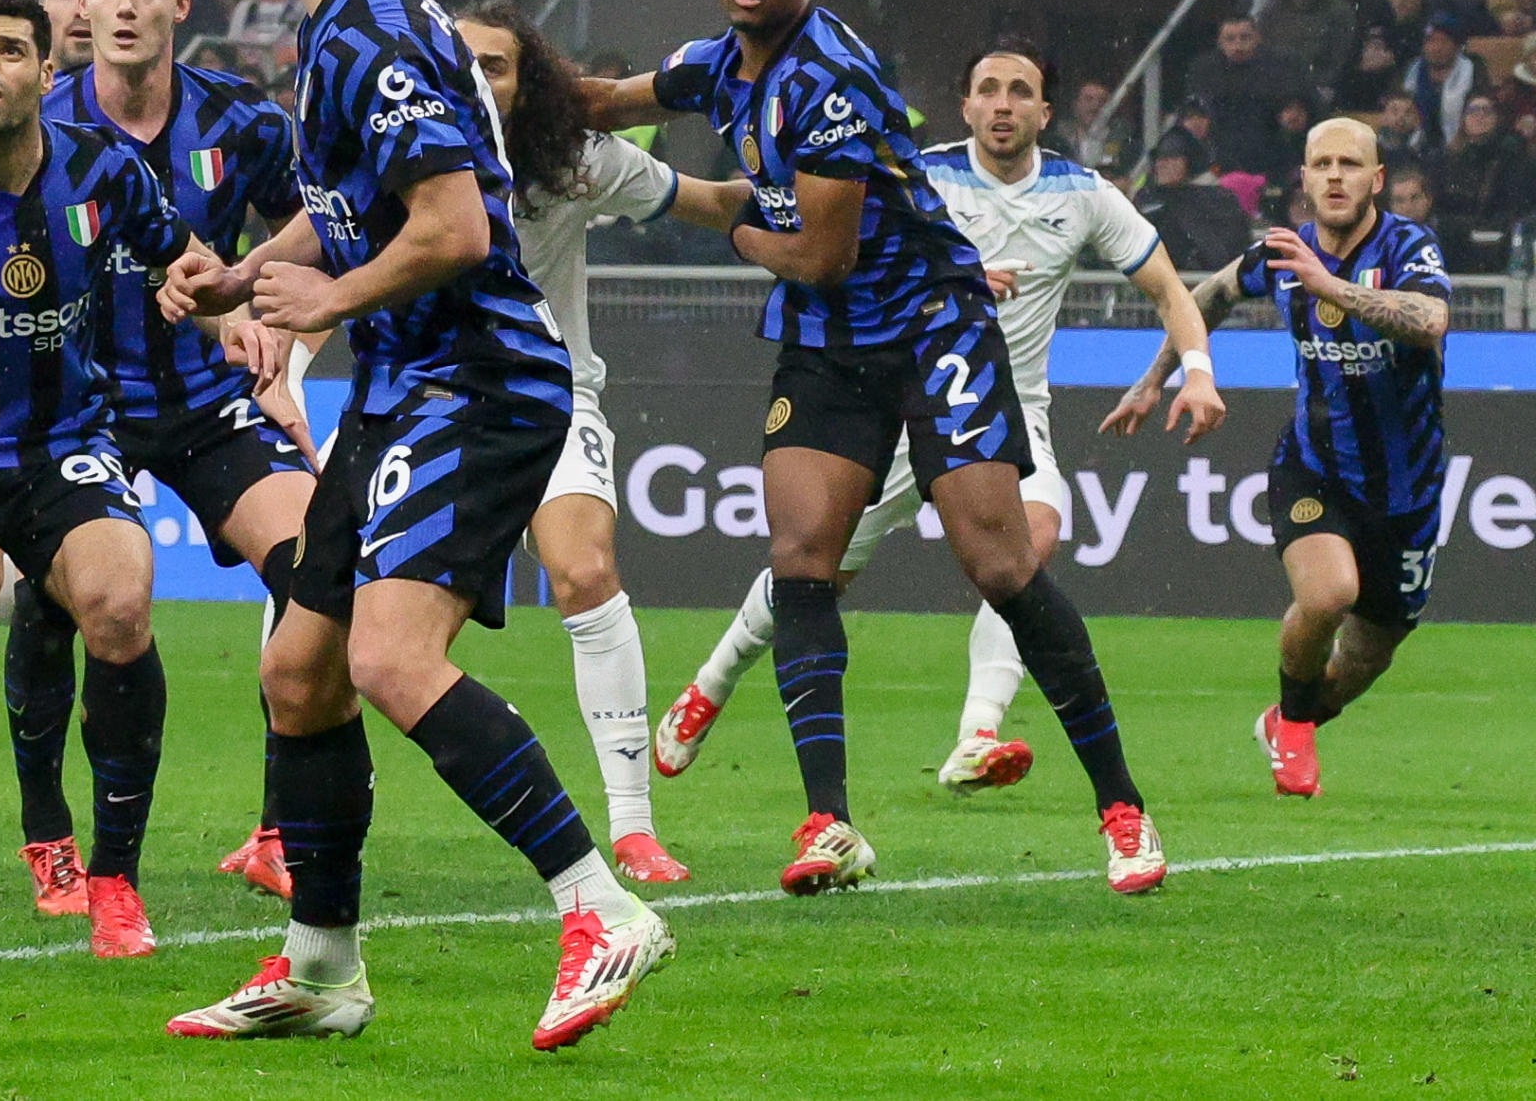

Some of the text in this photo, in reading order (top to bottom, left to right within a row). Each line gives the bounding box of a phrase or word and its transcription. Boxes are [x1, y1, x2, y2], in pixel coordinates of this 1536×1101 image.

[369, 99, 445, 134] Gate.io
[1297, 333, 1395, 363] etsson
[936, 353, 980, 407] 2
[579, 426, 608, 469] 8
